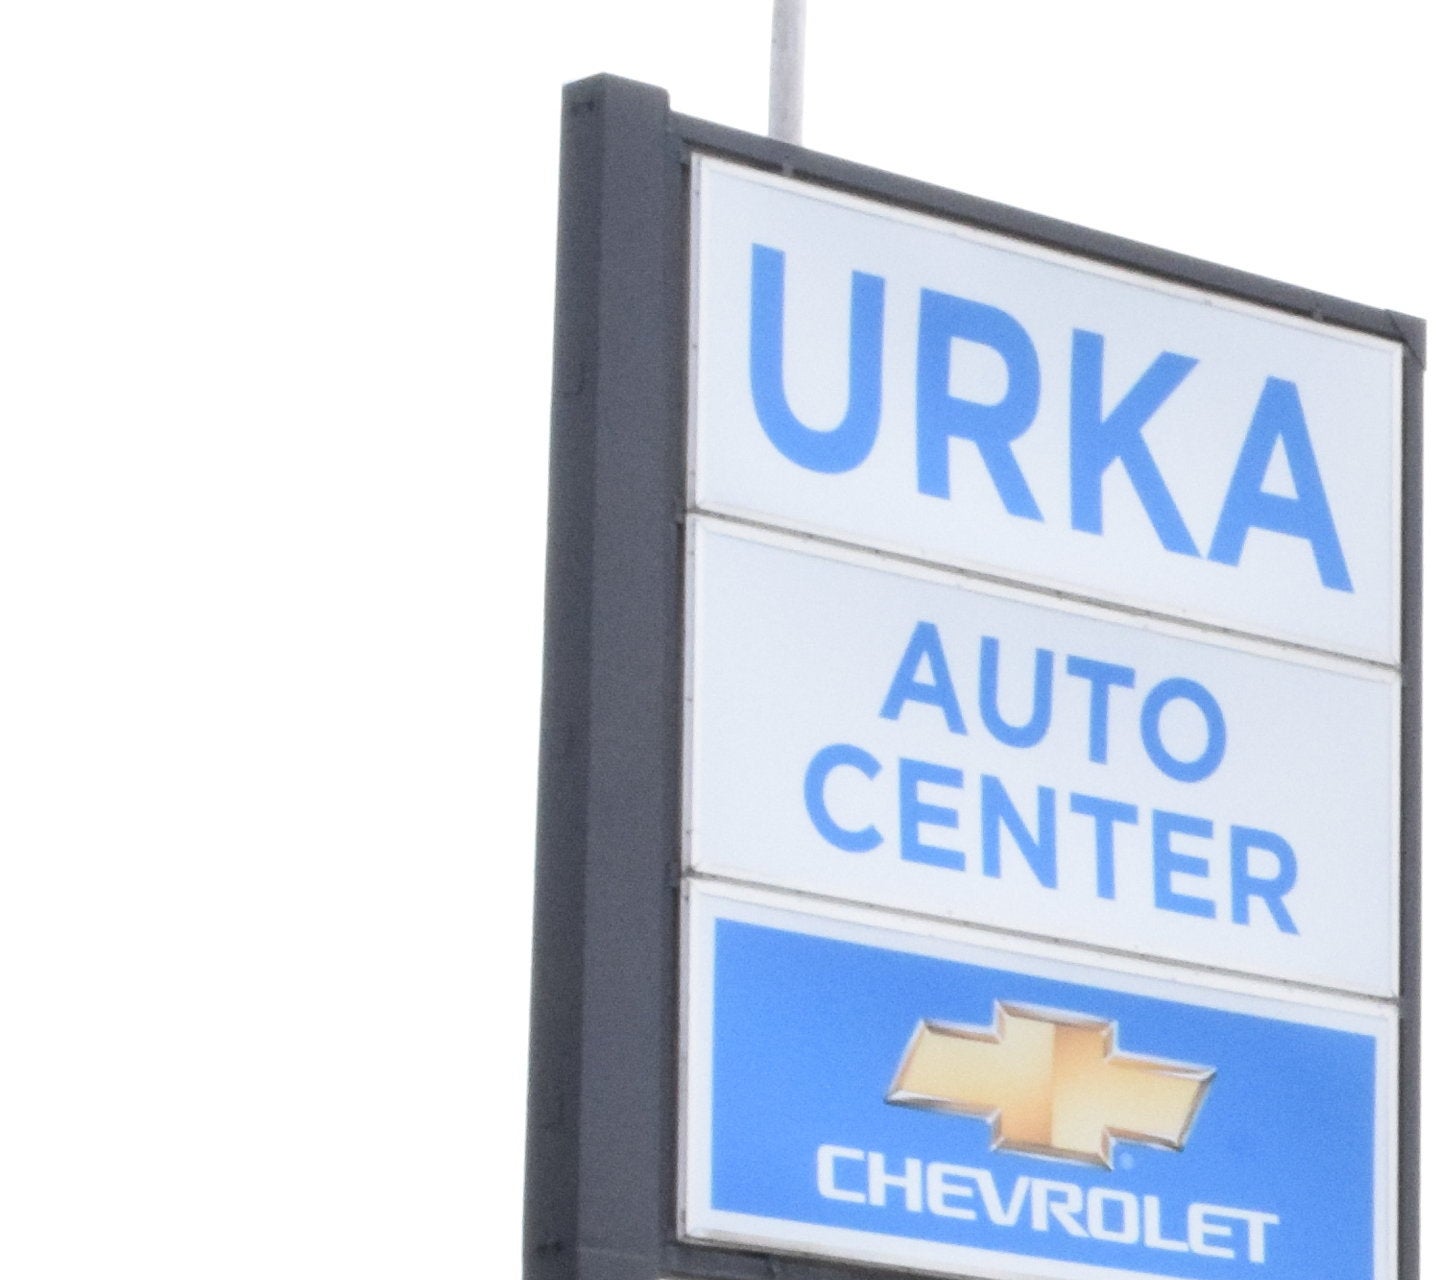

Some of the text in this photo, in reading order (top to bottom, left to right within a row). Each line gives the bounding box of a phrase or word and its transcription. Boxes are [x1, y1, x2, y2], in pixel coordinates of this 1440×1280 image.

[749, 241, 1356, 595] URKA
[878, 620, 1227, 784] AUTO
[803, 743, 1301, 936] CENTER
[816, 1144, 1280, 1264] CHEVROLET
